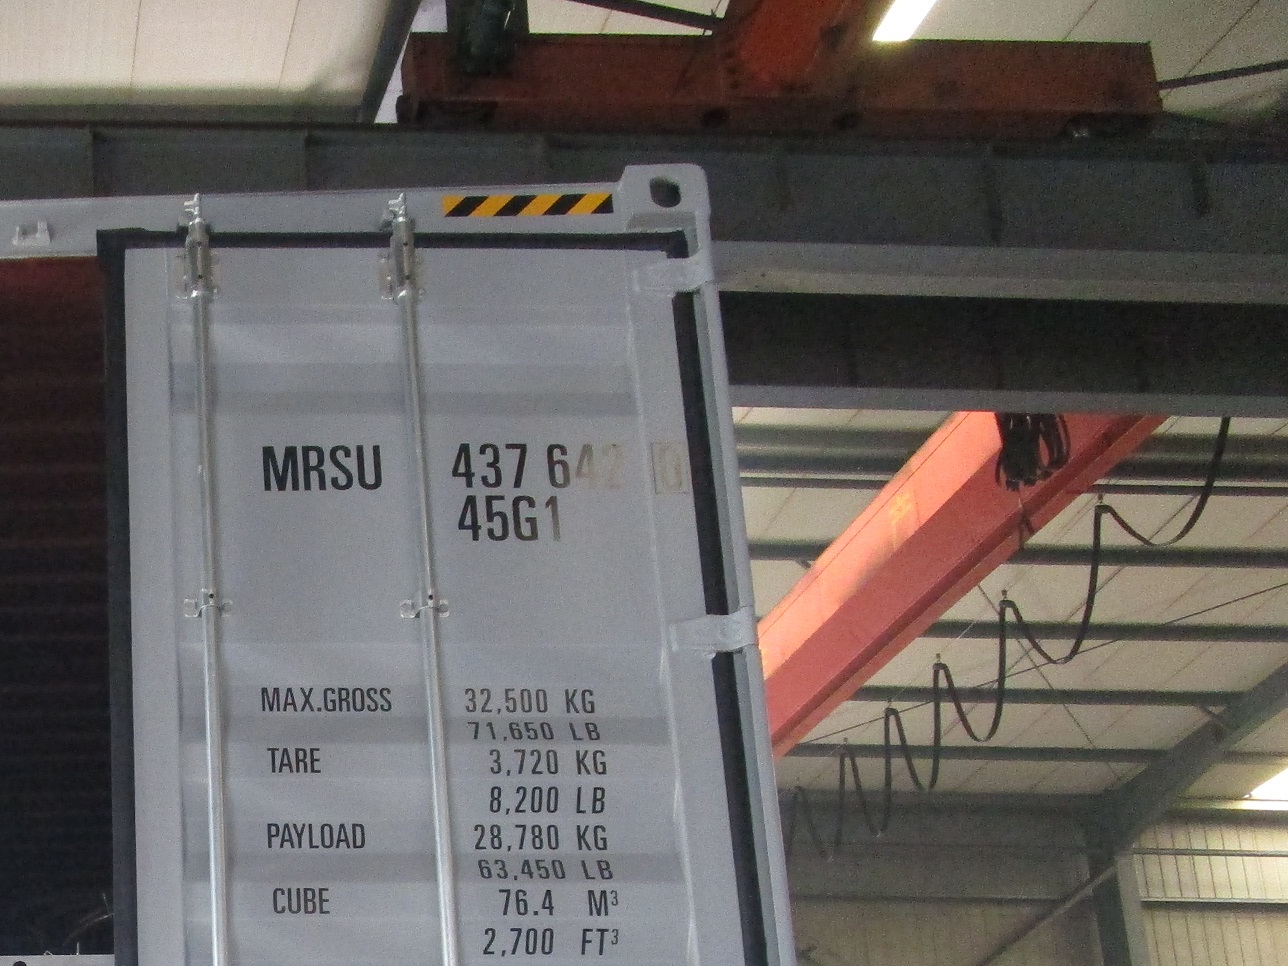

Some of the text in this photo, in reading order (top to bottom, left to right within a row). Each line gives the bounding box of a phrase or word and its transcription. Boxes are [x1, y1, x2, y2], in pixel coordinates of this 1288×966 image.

[262, 444, 383, 492] MRSU
[451, 442, 528, 489] 437
[457, 494, 561, 542] 45G1
[261, 687, 595, 715] MAX.GROSS 32,500 KG
[467, 721, 600, 742] 71,650 LB
[267, 747, 607, 777] TARE 3,720 KG
[489, 786, 605, 815] 8,200 LB
[266, 823, 608, 853] PAYLOAD 28,780 KG
[477, 859, 613, 882] 63,450 LB
[272, 888, 330, 915] CUBE
[498, 889, 555, 917] 76.4
[482, 928, 555, 957] 2,700
